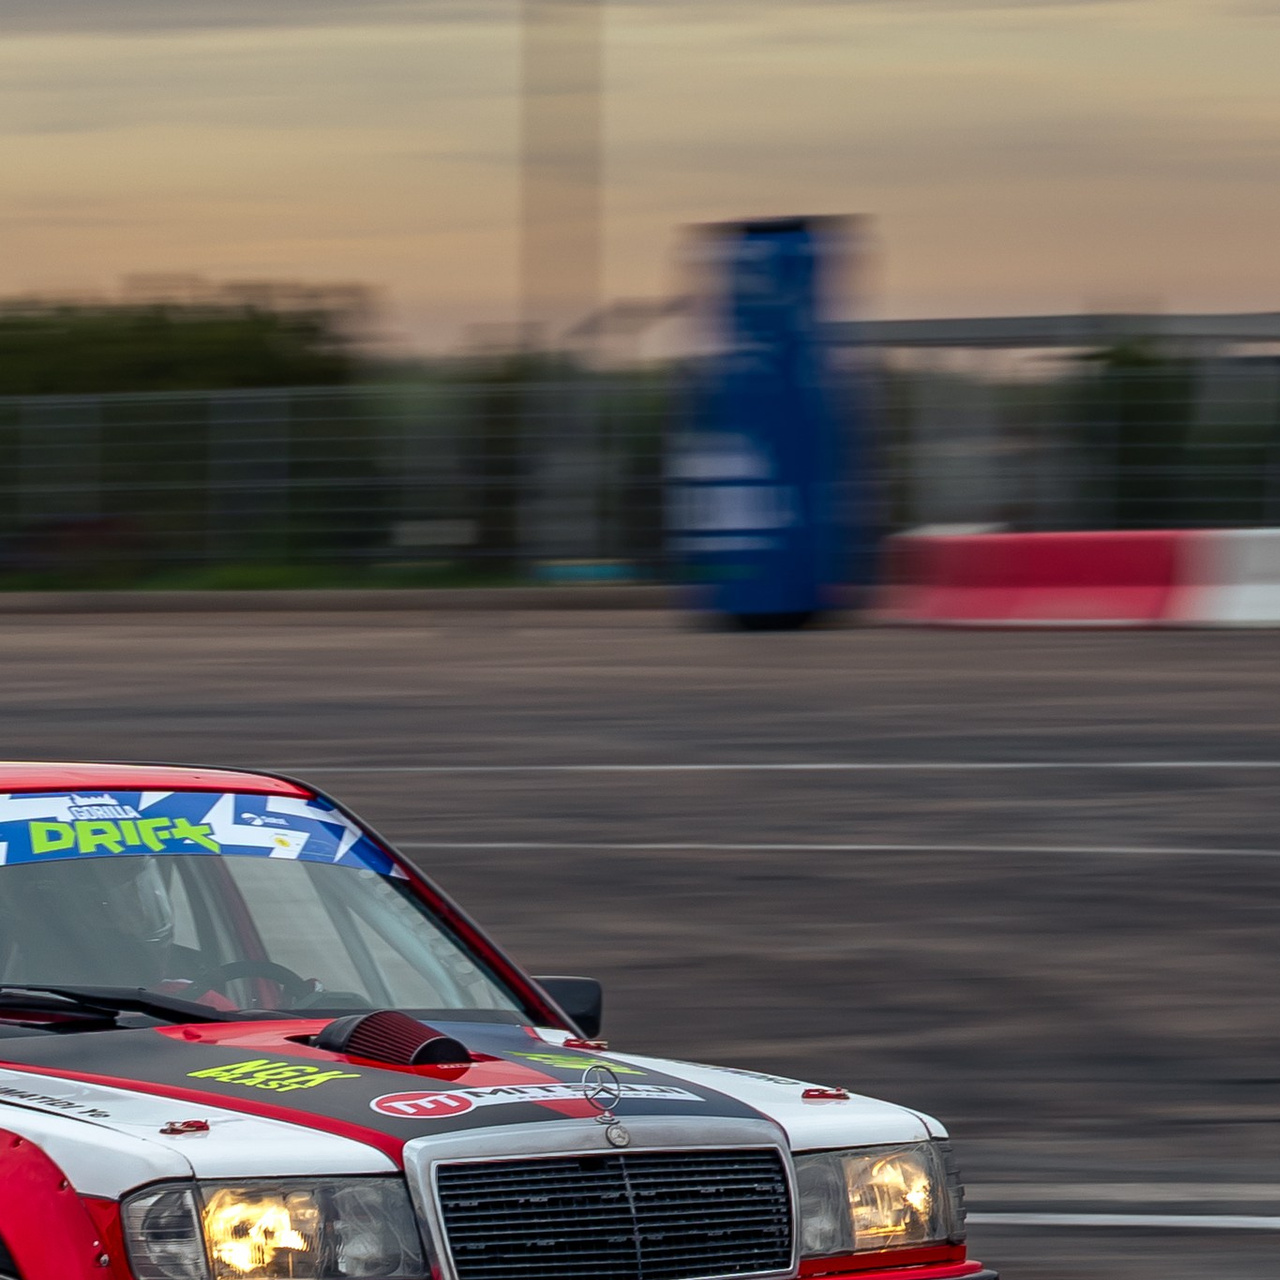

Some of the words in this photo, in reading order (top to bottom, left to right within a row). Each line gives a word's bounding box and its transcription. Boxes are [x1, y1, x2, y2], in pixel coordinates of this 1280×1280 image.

[70, 805, 142, 820] GORILLA
[29, 816, 221, 854] DRIFT
[186, 1059, 361, 1088] NGK
[196, 1072, 309, 1092] PLAST
